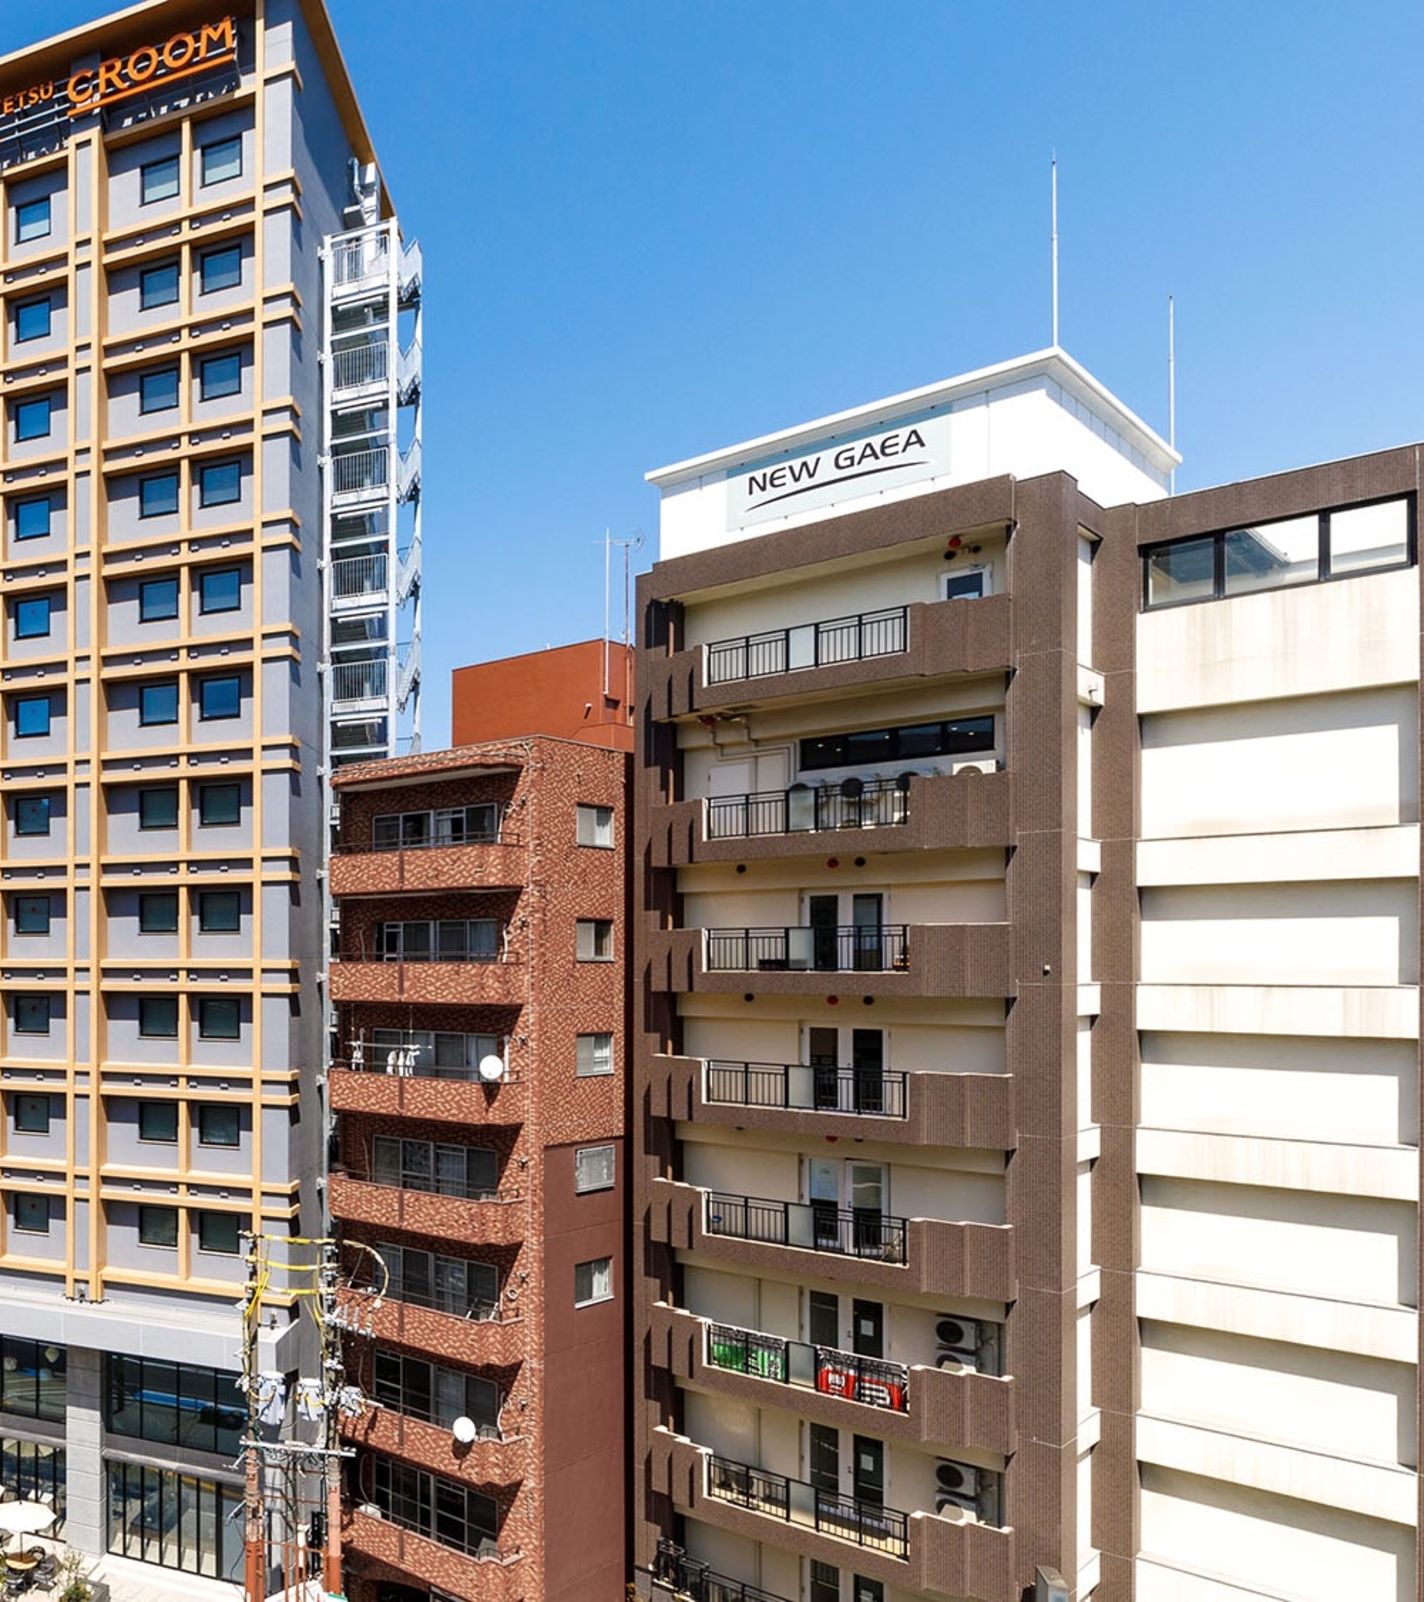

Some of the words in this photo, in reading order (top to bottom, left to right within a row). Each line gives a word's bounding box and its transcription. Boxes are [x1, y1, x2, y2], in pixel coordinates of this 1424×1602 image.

[67, 16, 234, 103] CROOM
[748, 456, 821, 496] NEW
[833, 428, 926, 470] GAEA
